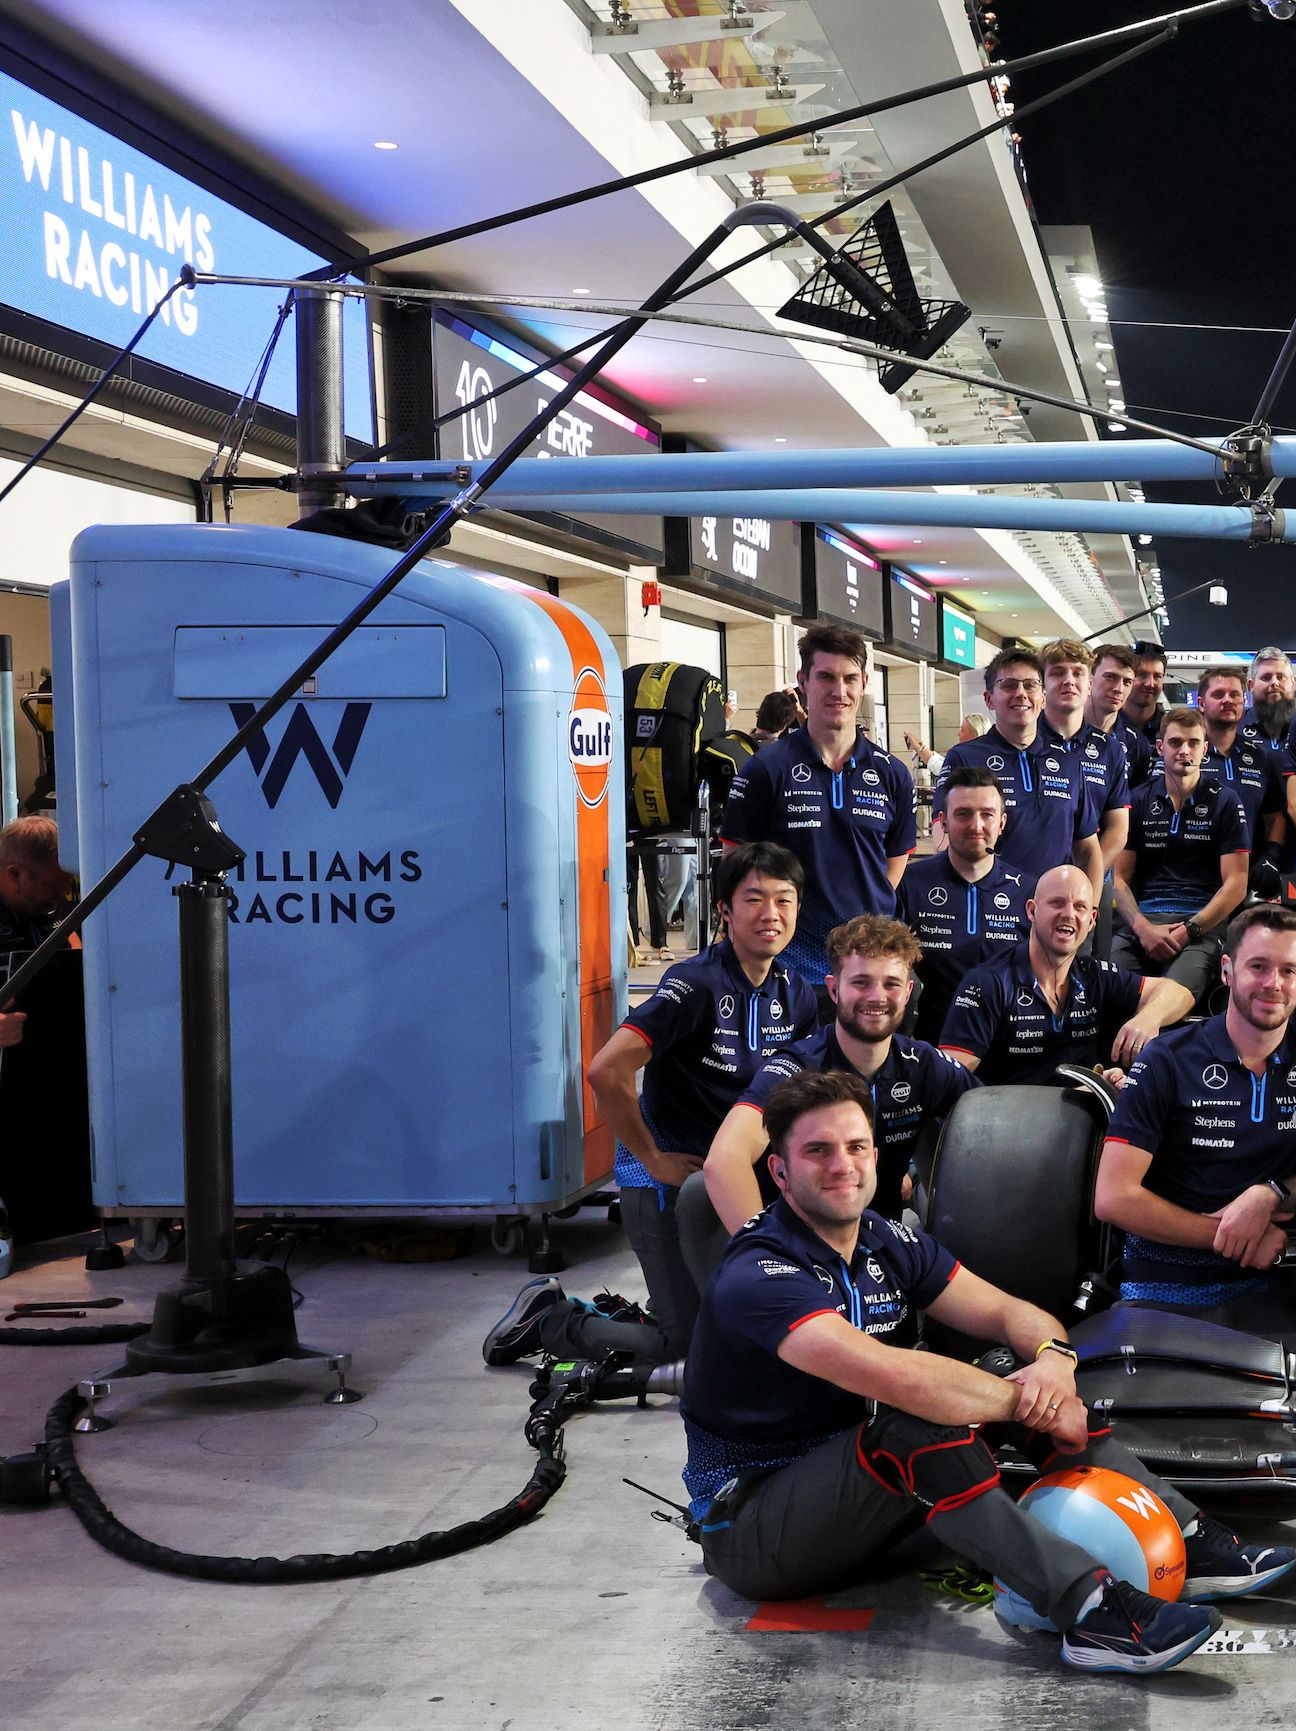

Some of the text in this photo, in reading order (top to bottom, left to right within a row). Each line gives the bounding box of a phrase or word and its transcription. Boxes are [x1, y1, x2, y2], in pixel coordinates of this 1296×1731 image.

[11, 109, 214, 272] WILLIAMS
[44, 211, 197, 336] RACING
[570, 717, 610, 756] Gulf
[852, 789, 888, 801] WILLIAMS
[1044, 790, 1071, 799] DURACELL
[856, 797, 884, 806] RACING
[788, 804, 821, 813] Stephens
[852, 808, 886, 820] DURACELL
[788, 819, 821, 828] KOMATSU
[236, 851, 421, 882] ILLIAMS
[985, 914, 1020, 922] WILLIAMS
[920, 924, 952, 935] Stephens
[986, 932, 1018, 941] DURACELL
[765, 1033, 792, 1042] RACING
[1016, 1029, 1043, 1040] tephens
[882, 1105, 923, 1119] WILLIAMS
[1195, 1116, 1235, 1128] Stephens
[1192, 1138, 1234, 1148] KOMATSU
